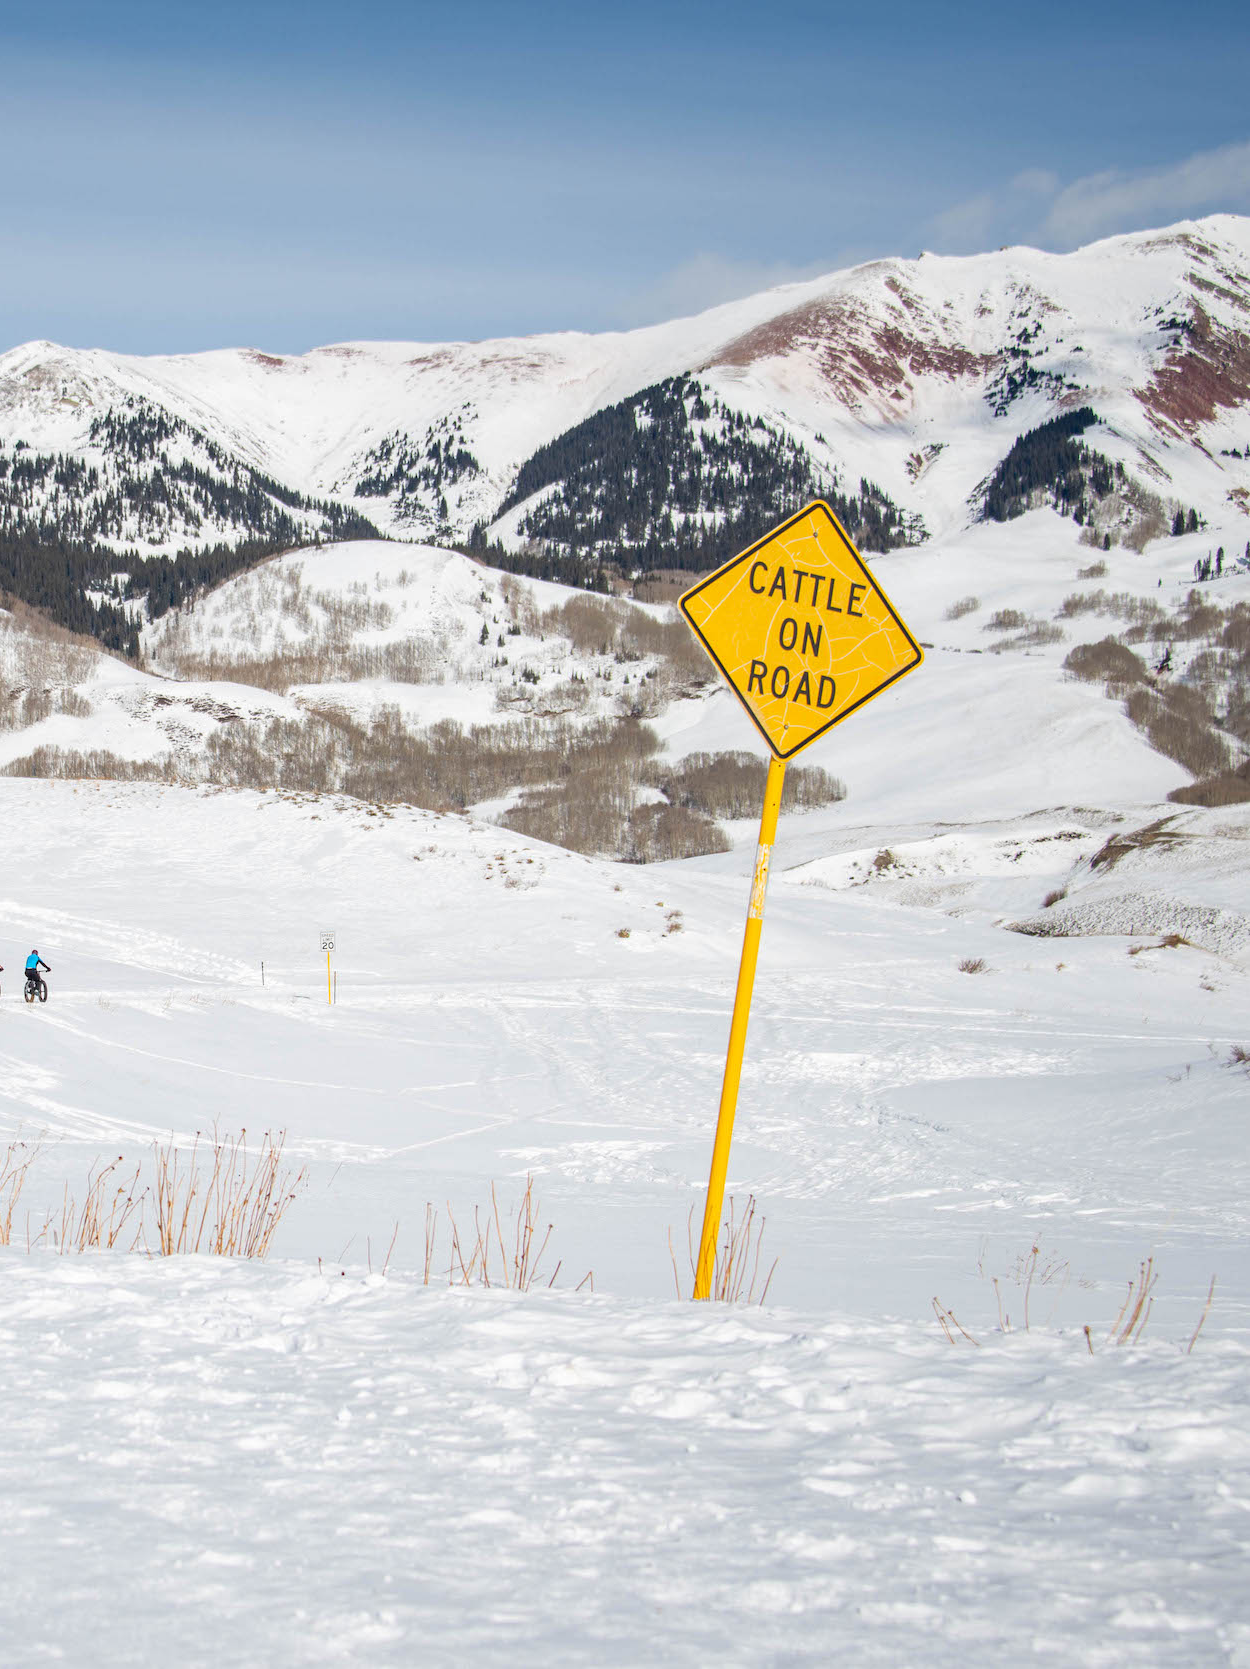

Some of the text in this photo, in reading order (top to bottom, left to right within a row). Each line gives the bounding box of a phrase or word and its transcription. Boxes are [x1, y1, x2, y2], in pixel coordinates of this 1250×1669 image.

[749, 561, 867, 618] CATTLE
[779, 617, 823, 657] ON
[747, 659, 837, 709] ROAD
